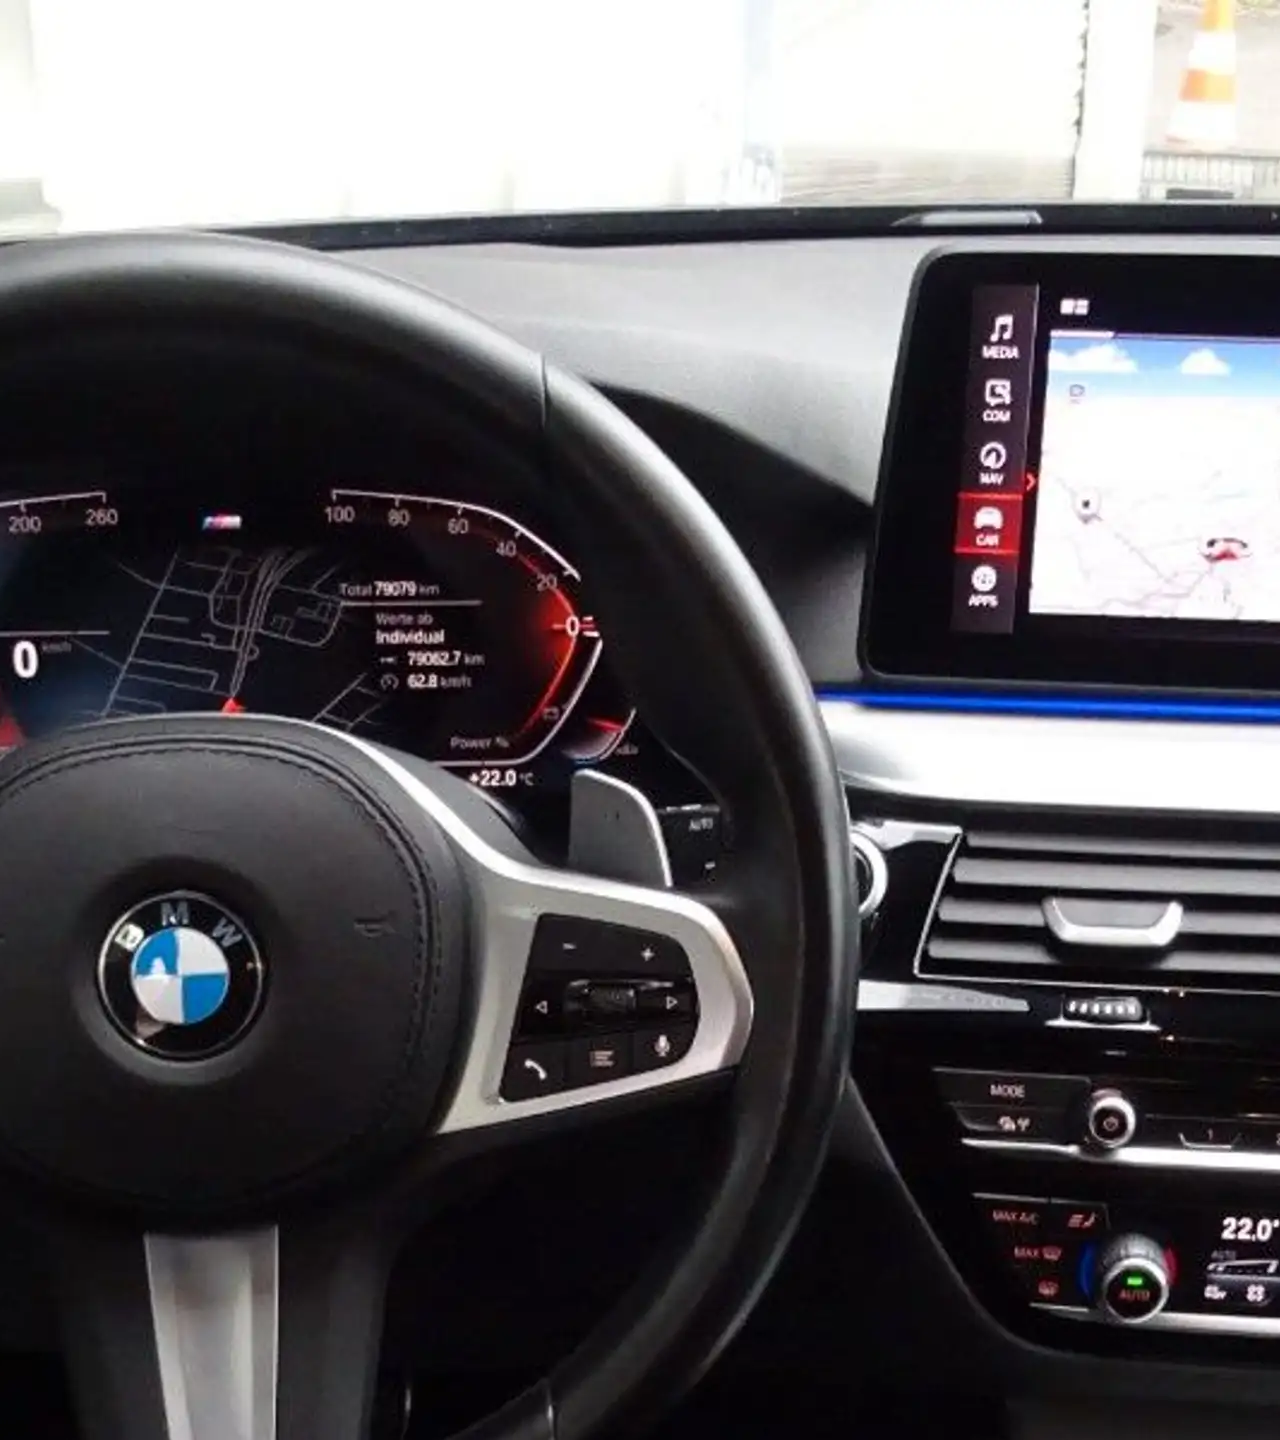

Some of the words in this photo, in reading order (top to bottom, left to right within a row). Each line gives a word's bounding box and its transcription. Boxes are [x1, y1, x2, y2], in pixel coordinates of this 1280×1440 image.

[982, 345, 1019, 359] MEDIA
[983, 410, 1011, 422] COM
[979, 472, 1006, 485] NAV
[85, 508, 119, 526] 260
[325, 506, 356, 523] 100
[387, 508, 411, 526] 80
[8, 516, 42, 534] 200
[448, 518, 470, 535] 60
[976, 533, 1000, 546] CAR
[496, 541, 517, 558] 40
[340, 582, 372, 597] Total
[373, 580, 418, 597] 79079
[419, 584, 440, 596] km
[536, 573, 557, 591] 20
[968, 594, 999, 608] APPS
[376, 613, 414, 626] Werte
[417, 612, 433, 626] ab
[566, 615, 580, 637] 0
[375, 630, 445, 645] Individual
[12, 640, 39, 679] 0
[464, 653, 485, 666] km
[407, 674, 438, 688] 62.8
[450, 736, 492, 750] Power
[114, 900, 244, 953] BMW
[990, 1084, 1026, 1098] MODE
[1119, 1289, 1151, 1301] AUTO
